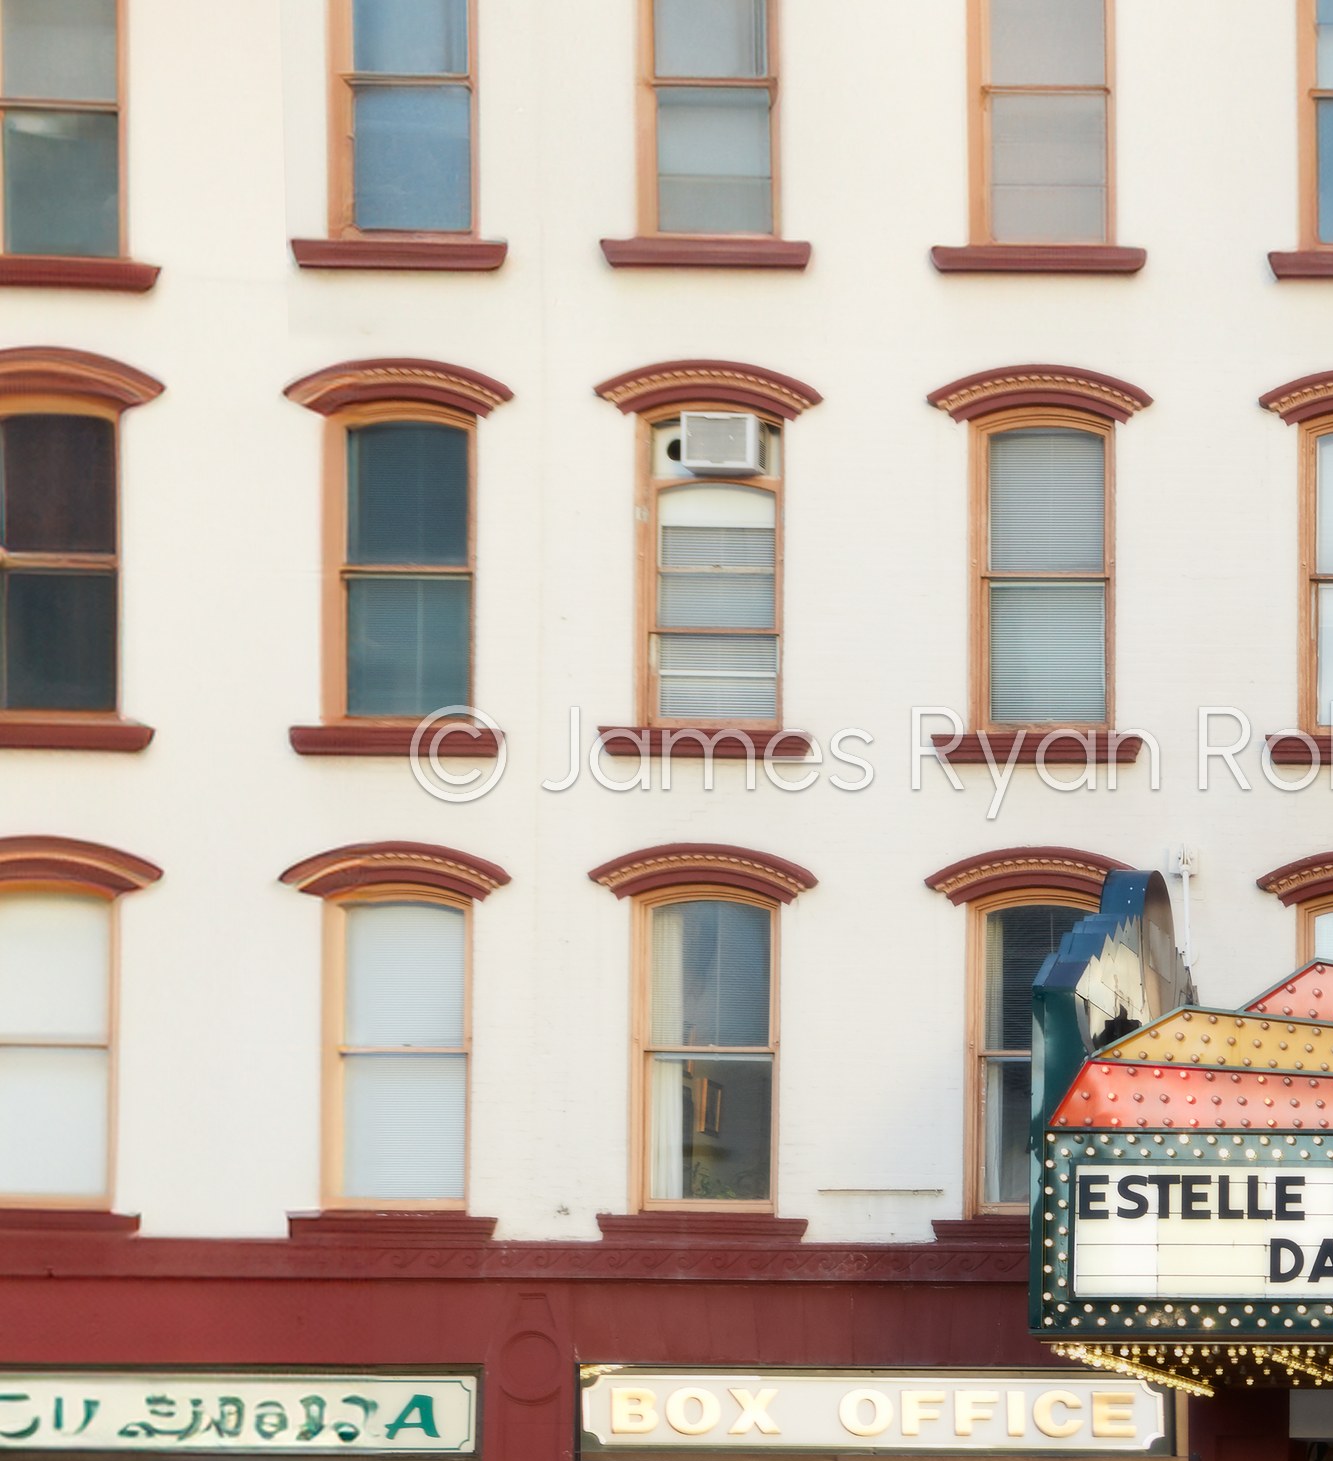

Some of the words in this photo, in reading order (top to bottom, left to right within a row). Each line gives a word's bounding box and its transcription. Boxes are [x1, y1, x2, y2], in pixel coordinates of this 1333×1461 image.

[1078, 1174, 1305, 1221] ESTELLE
[610, 1387, 781, 1436] BOX
[839, 1390, 1138, 1438] OFFICE
